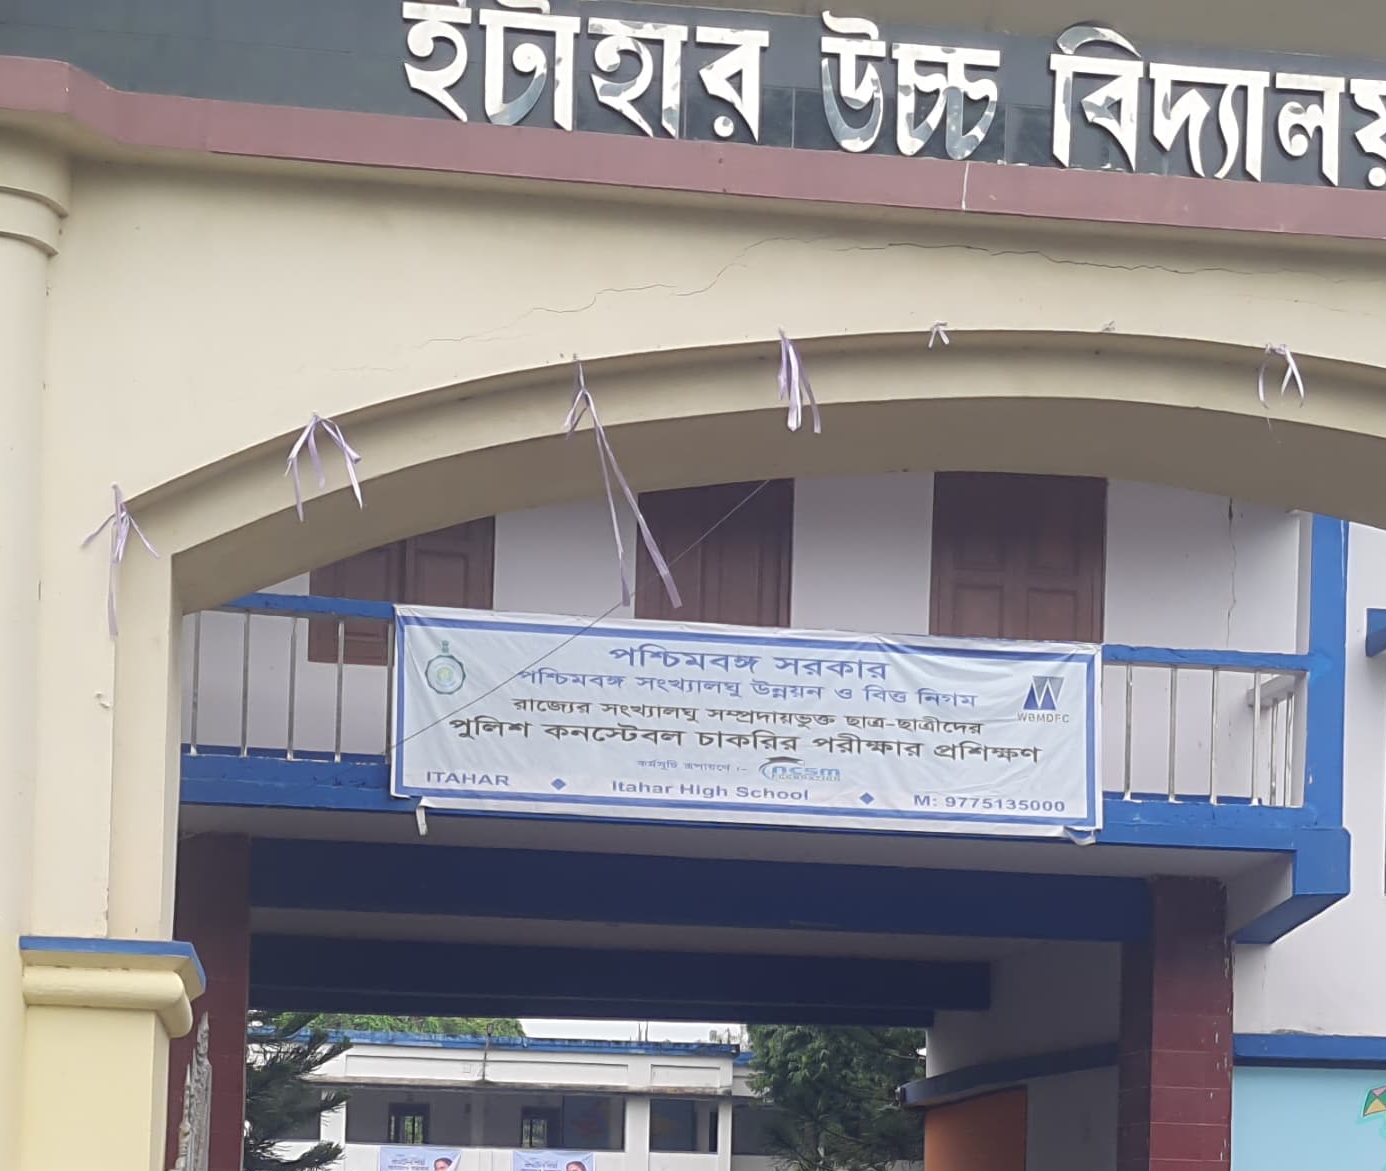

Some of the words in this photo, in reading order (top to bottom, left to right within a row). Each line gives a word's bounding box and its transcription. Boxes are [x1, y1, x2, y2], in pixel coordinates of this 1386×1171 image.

[402, 0, 770, 144] ইটাহার
[820, 10, 1001, 161] উচ্চ
[609, 643, 761, 674] পশ্চিমবঙ্গ
[775, 657, 890, 681] সরকার
[516, 667, 626, 689] পশ্চিমবঙ্গ
[637, 676, 742, 698] সংখ্যালঘু
[751, 679, 823, 702] উন্নয়ন
[834, 688, 853, 701] ও
[861, 684, 908, 705] বিত্ত
[917, 687, 978, 708] নিগম
[512, 697, 591, 715] রাজ্যের
[601, 702, 700, 722] সংখ্যালঘু
[707, 707, 838, 731] সম্প্রদায়ভুক্ত
[844, 713, 984, 736] ছাত্র-ছাত্রীদের
[449, 715, 532, 741] পুলিশ
[541, 722, 686, 748] কনস্টেবল
[694, 728, 801, 752] চাকরির
[812, 731, 926, 757] পরীক্ষার
[934, 740, 1043, 764] প্রশিক্ষণ
[426, 771, 509, 787] ITAHAR
[612, 780, 675, 796] Itahar
[680, 783, 728, 800] High
[735, 785, 810, 802] School
[914, 793, 938, 807] M:
[945, 796, 1066, 814] 9775135000
